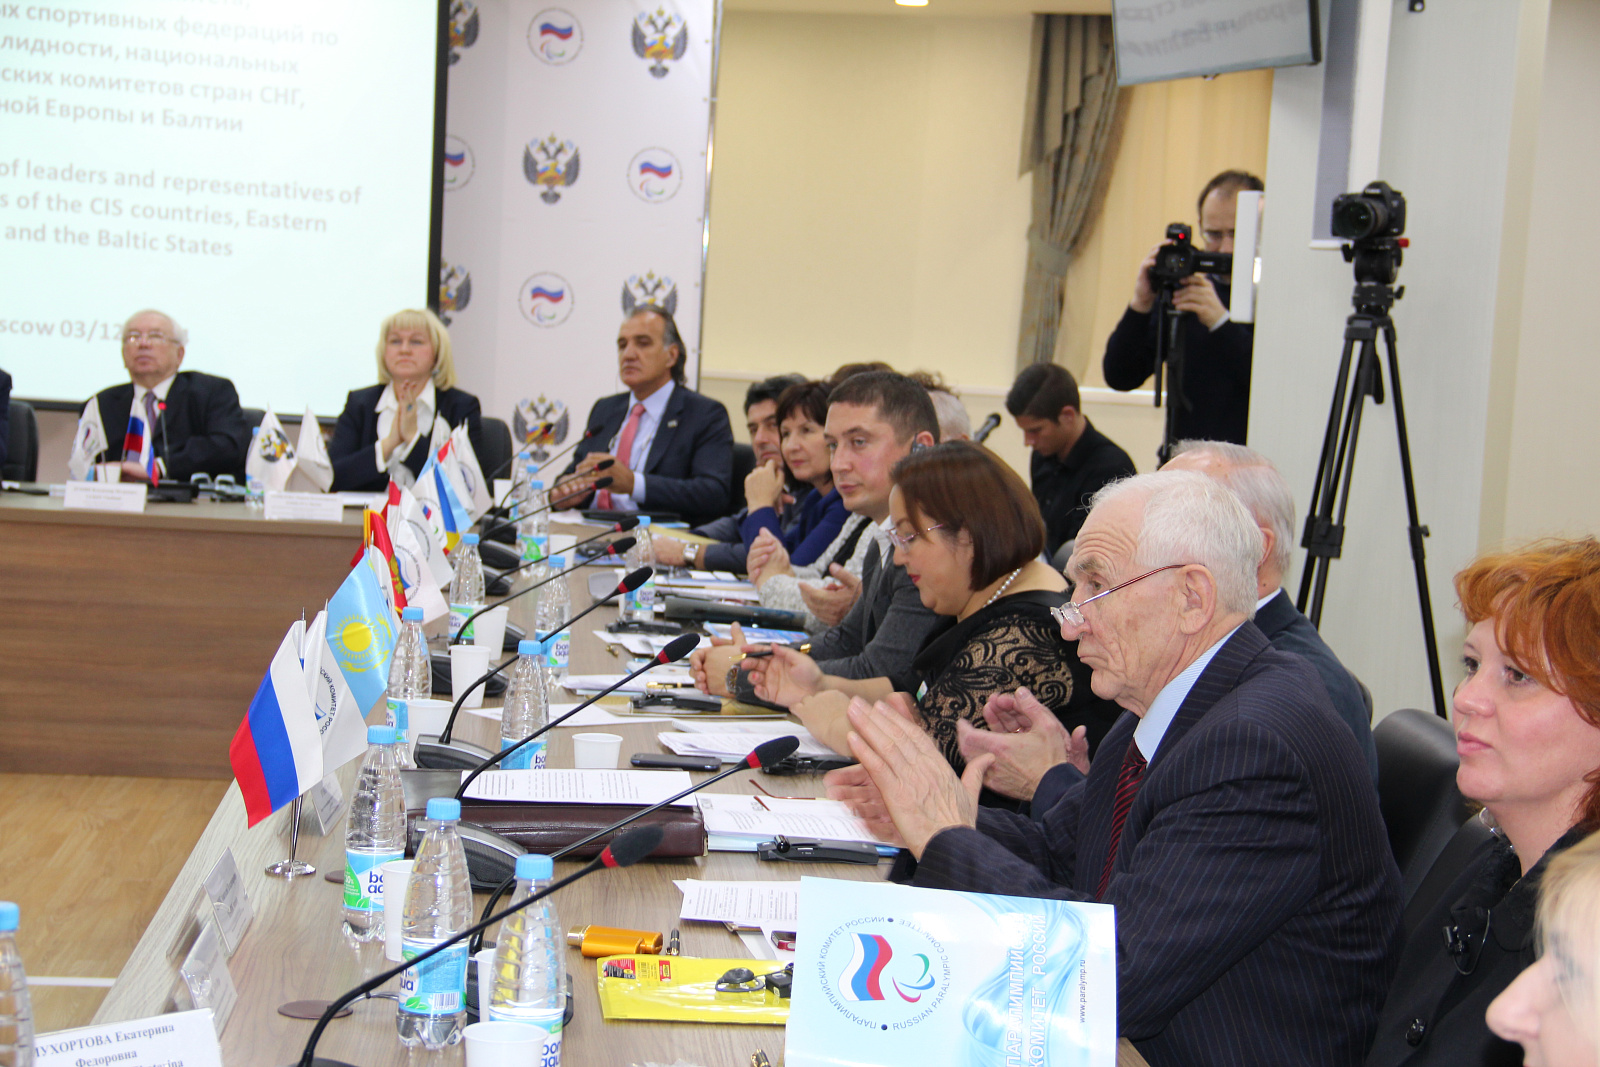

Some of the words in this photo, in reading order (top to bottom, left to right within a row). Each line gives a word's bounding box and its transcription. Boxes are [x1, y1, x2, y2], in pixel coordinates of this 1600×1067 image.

[26, 5, 166, 31] спортивных
[173, 15, 303, 44] федераций
[311, 31, 339, 46] по
[1, 35, 119, 62] лидности,
[126, 46, 298, 74] национальных
[60, 73, 184, 97] комитетов
[190, 84, 252, 103] стран
[260, 86, 305, 110] СНГ,
[46, 99, 133, 123] Европы
[141, 111, 154, 125] и
[162, 108, 243, 132] Балтии
[0, 158, 20, 177] of
[27, 159, 107, 185] leaders
[114, 169, 155, 188] and
[163, 175, 334, 203] representatives
[339, 186, 362, 204] of
[17, 191, 39, 210] of
[47, 193, 82, 213] the
[90, 197, 123, 217] CIS
[131, 204, 240, 229] countries,
[246, 209, 327, 232] Eastern
[5, 223, 46, 242] and
[54, 225, 90, 246] the
[98, 229, 159, 251] Baltic
[165, 234, 233, 257] States
[60, 319, 122, 343] 03/12
[319, 717, 334, 735] РОСС
[844, 915, 886, 931] РОССИИ
[819, 925, 845, 960] КОМИТЕТ
[1031, 914, 1047, 975] РОССИИ
[817, 961, 877, 1030] ПАРАЛИМПИЙСКИЙ
[892, 1006, 933, 1031] RUSSIAN
[930, 954, 951, 1010] PARALYMPIC
[1078, 959, 1087, 1024] www.paralymp.ru
[115, 1023, 175, 1042] Екатерина
[75, 1049, 138, 1067] Федоровна
